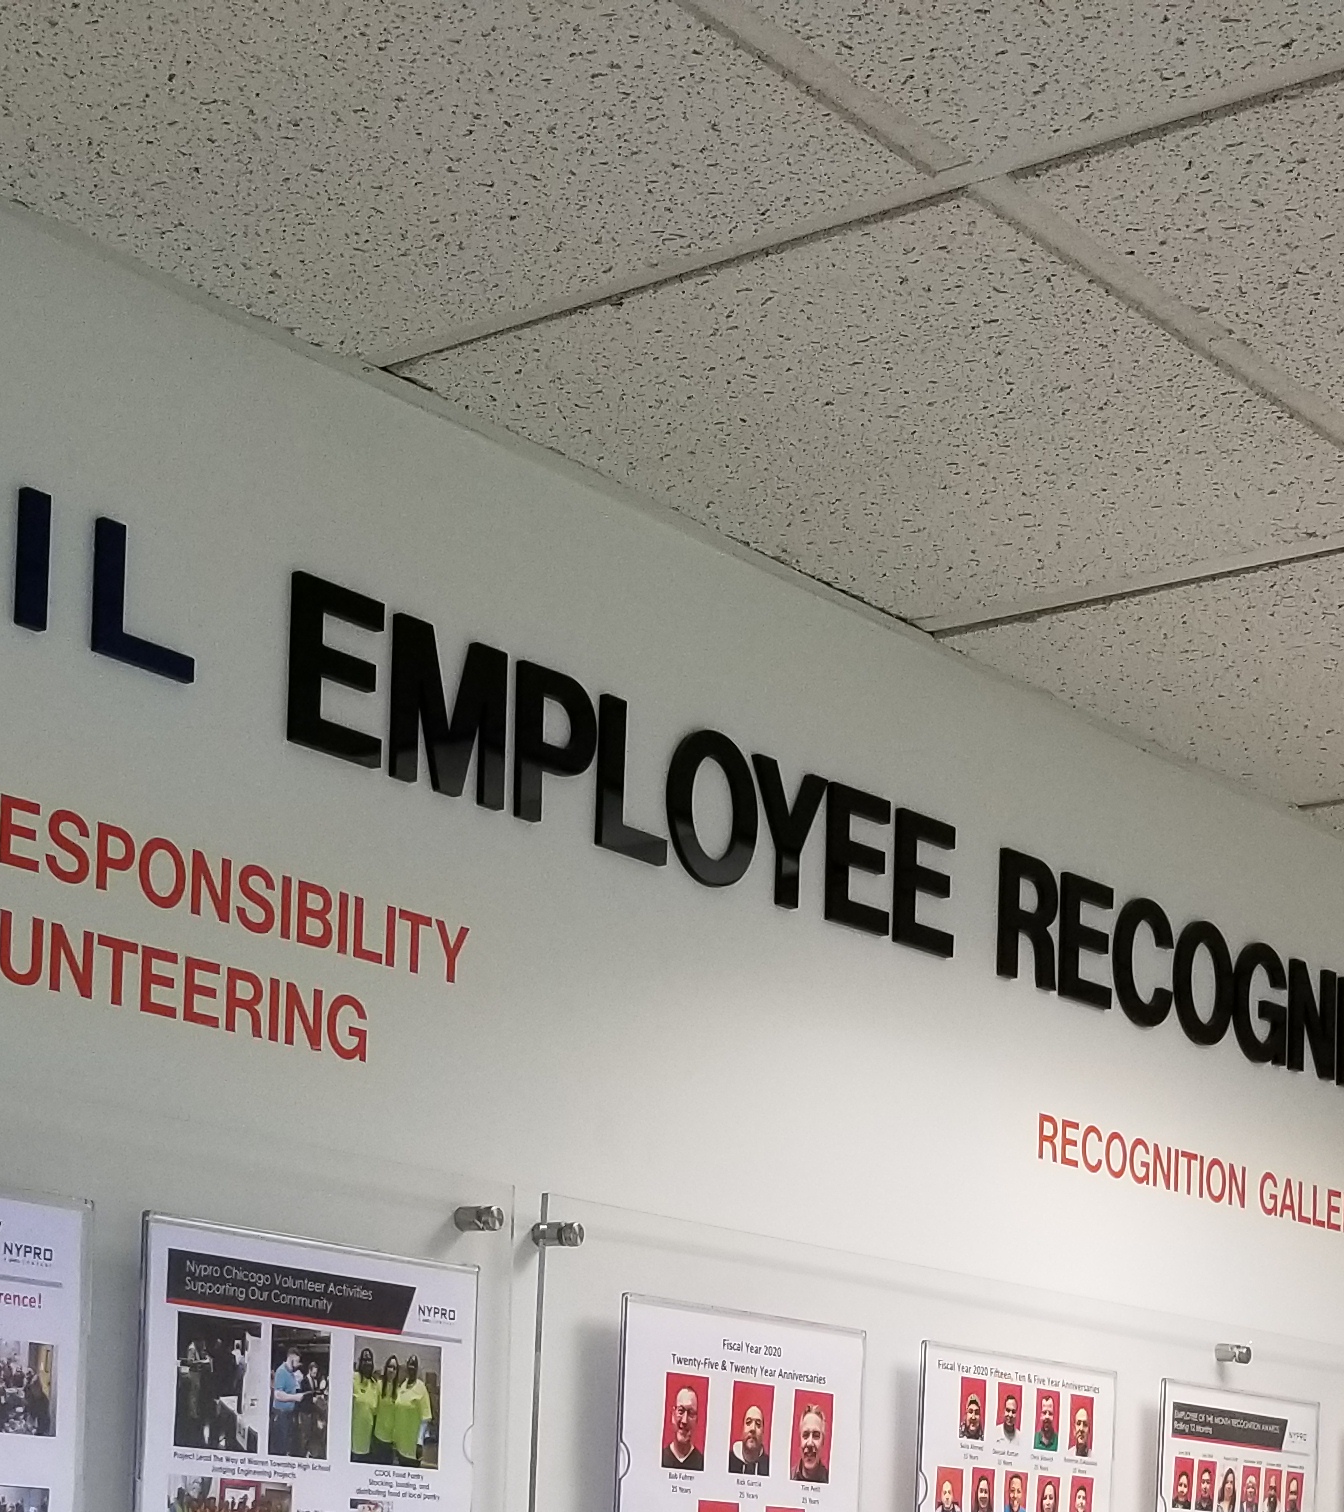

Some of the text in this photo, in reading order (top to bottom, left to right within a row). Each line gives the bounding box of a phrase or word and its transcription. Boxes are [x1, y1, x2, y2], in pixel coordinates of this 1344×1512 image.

[286, 570, 955, 958] EMPLOYEE
[1036, 1113, 1248, 1212] RECOGNITION
[3, 1241, 54, 1261] NYPRO
[185, 1276, 333, 1314] Supporting Our Community
[186, 1259, 373, 1301] Nypro Chicago Volunteer Activities
[418, 1305, 455, 1320] NYPRO
[722, 1338, 782, 1358] Fiscal Year 2020
[671, 1353, 826, 1385] Twenty-Five & Twenty Year Anniversaries
